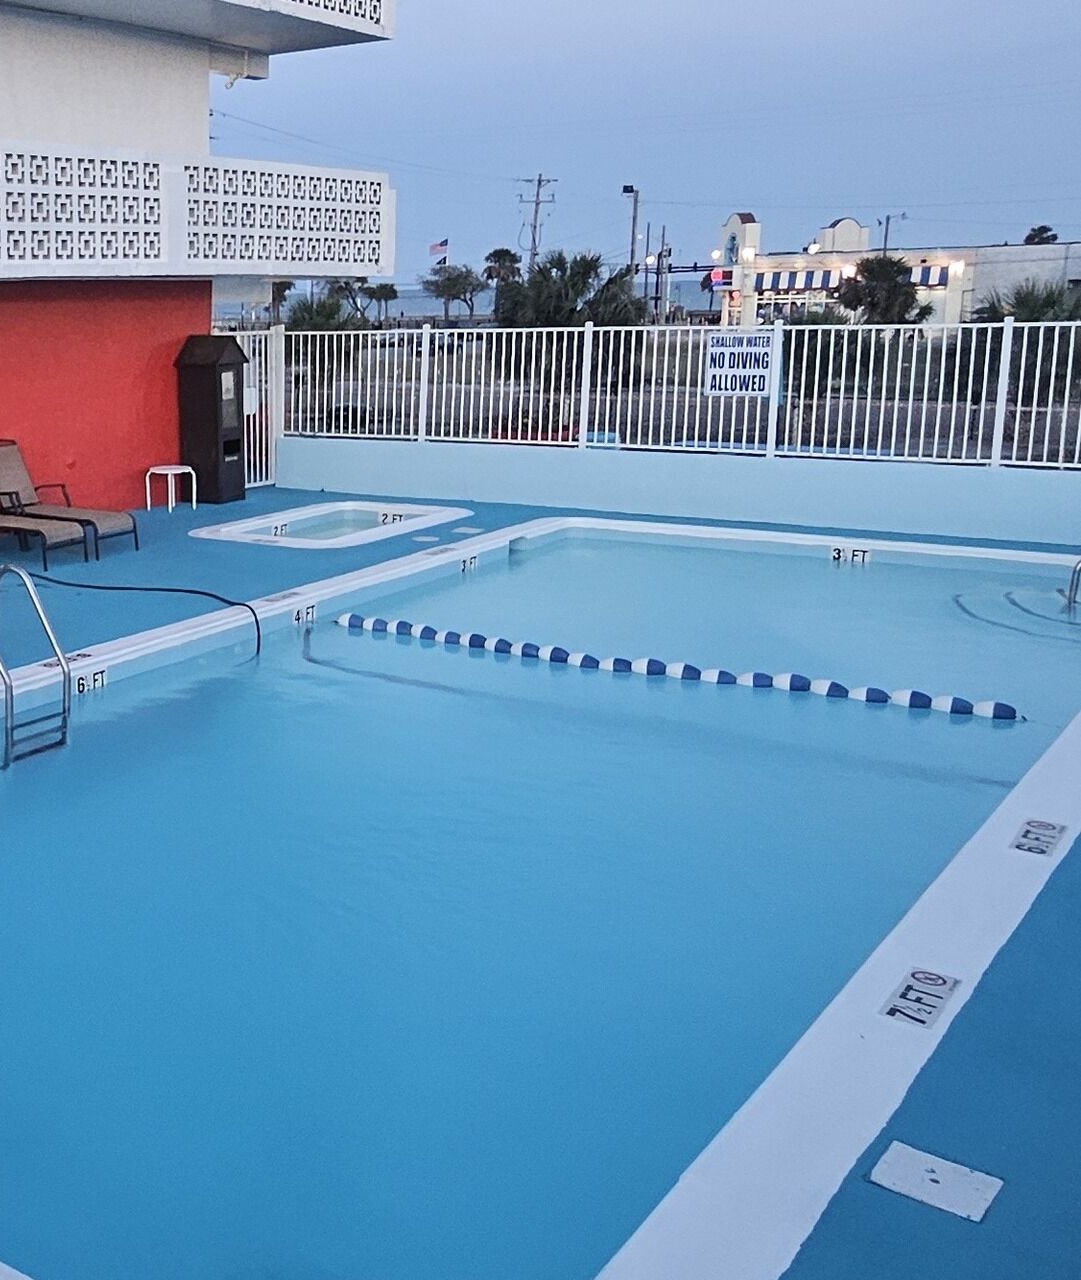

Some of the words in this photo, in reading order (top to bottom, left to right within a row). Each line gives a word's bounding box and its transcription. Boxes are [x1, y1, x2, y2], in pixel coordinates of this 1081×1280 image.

[711, 336, 744, 348] SHALLOW
[745, 336, 771, 348] WATER
[709, 351, 725, 369] NO
[728, 351, 769, 369] DIVING
[710, 374, 766, 392] ALLOWED
[392, 514, 403, 524] FT
[280, 524, 287, 535] FT
[851, 549, 869, 562] FT
[93, 670, 106, 690] FT
[1021, 829, 1056, 845] FT
[899, 984, 944, 1008] FT
